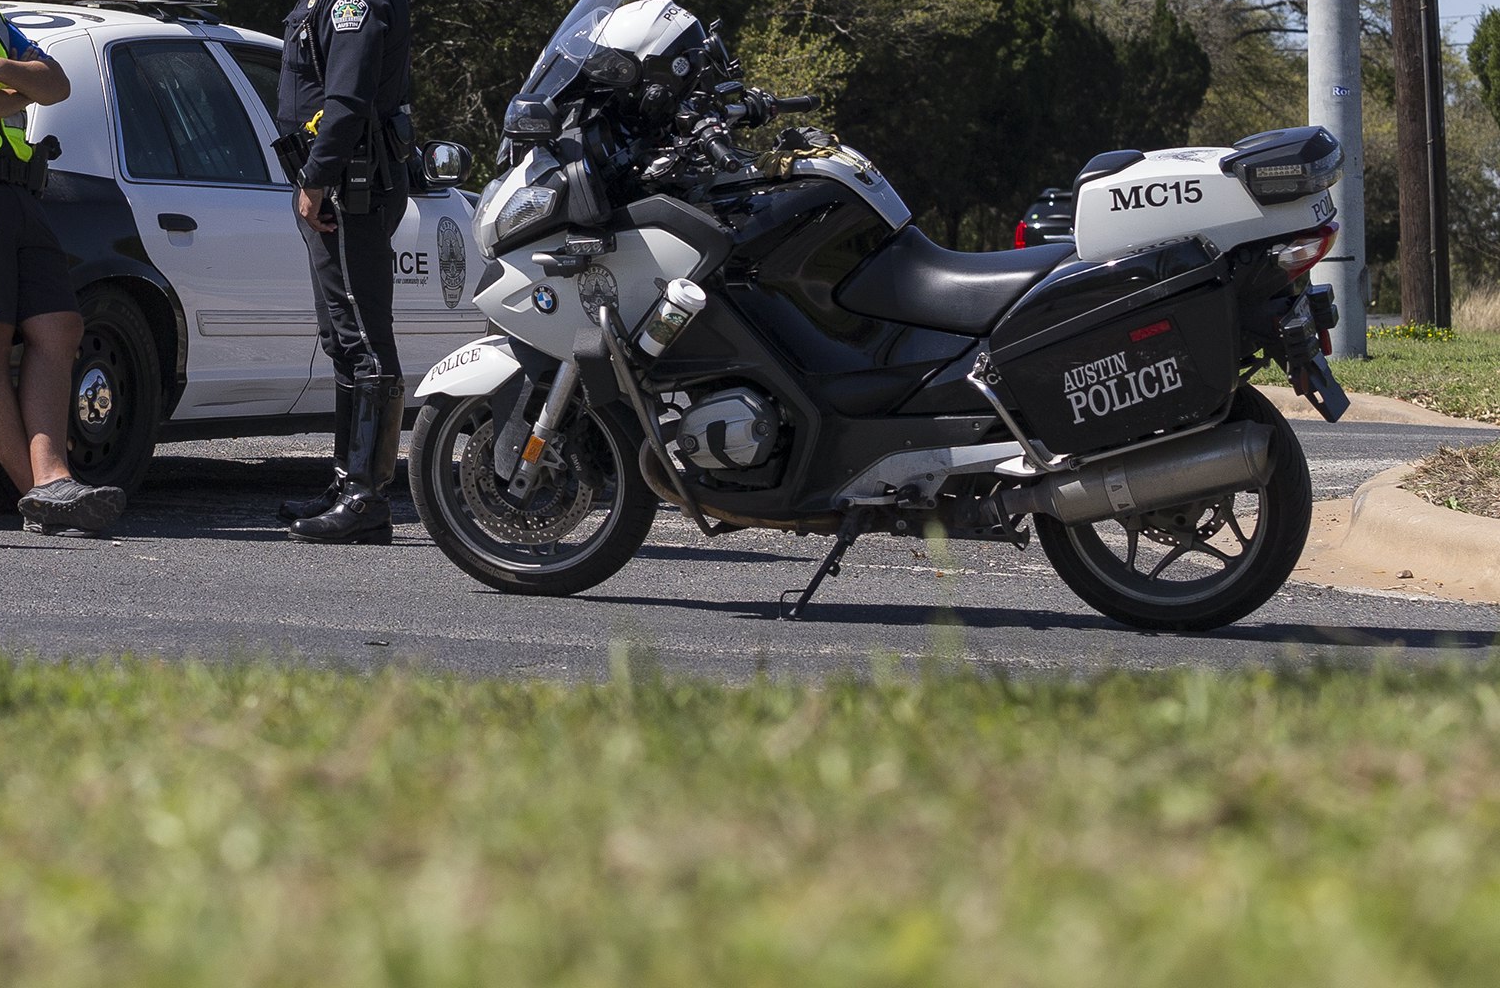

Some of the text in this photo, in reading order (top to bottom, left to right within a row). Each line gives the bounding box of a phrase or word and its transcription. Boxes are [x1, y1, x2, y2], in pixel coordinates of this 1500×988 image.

[1109, 179, 1203, 211] MC15
[393, 252, 429, 274] ICE
[430, 348, 481, 381] POLICE
[1063, 351, 1127, 393] AUSTIN
[1066, 357, 1183, 425] POLICE
